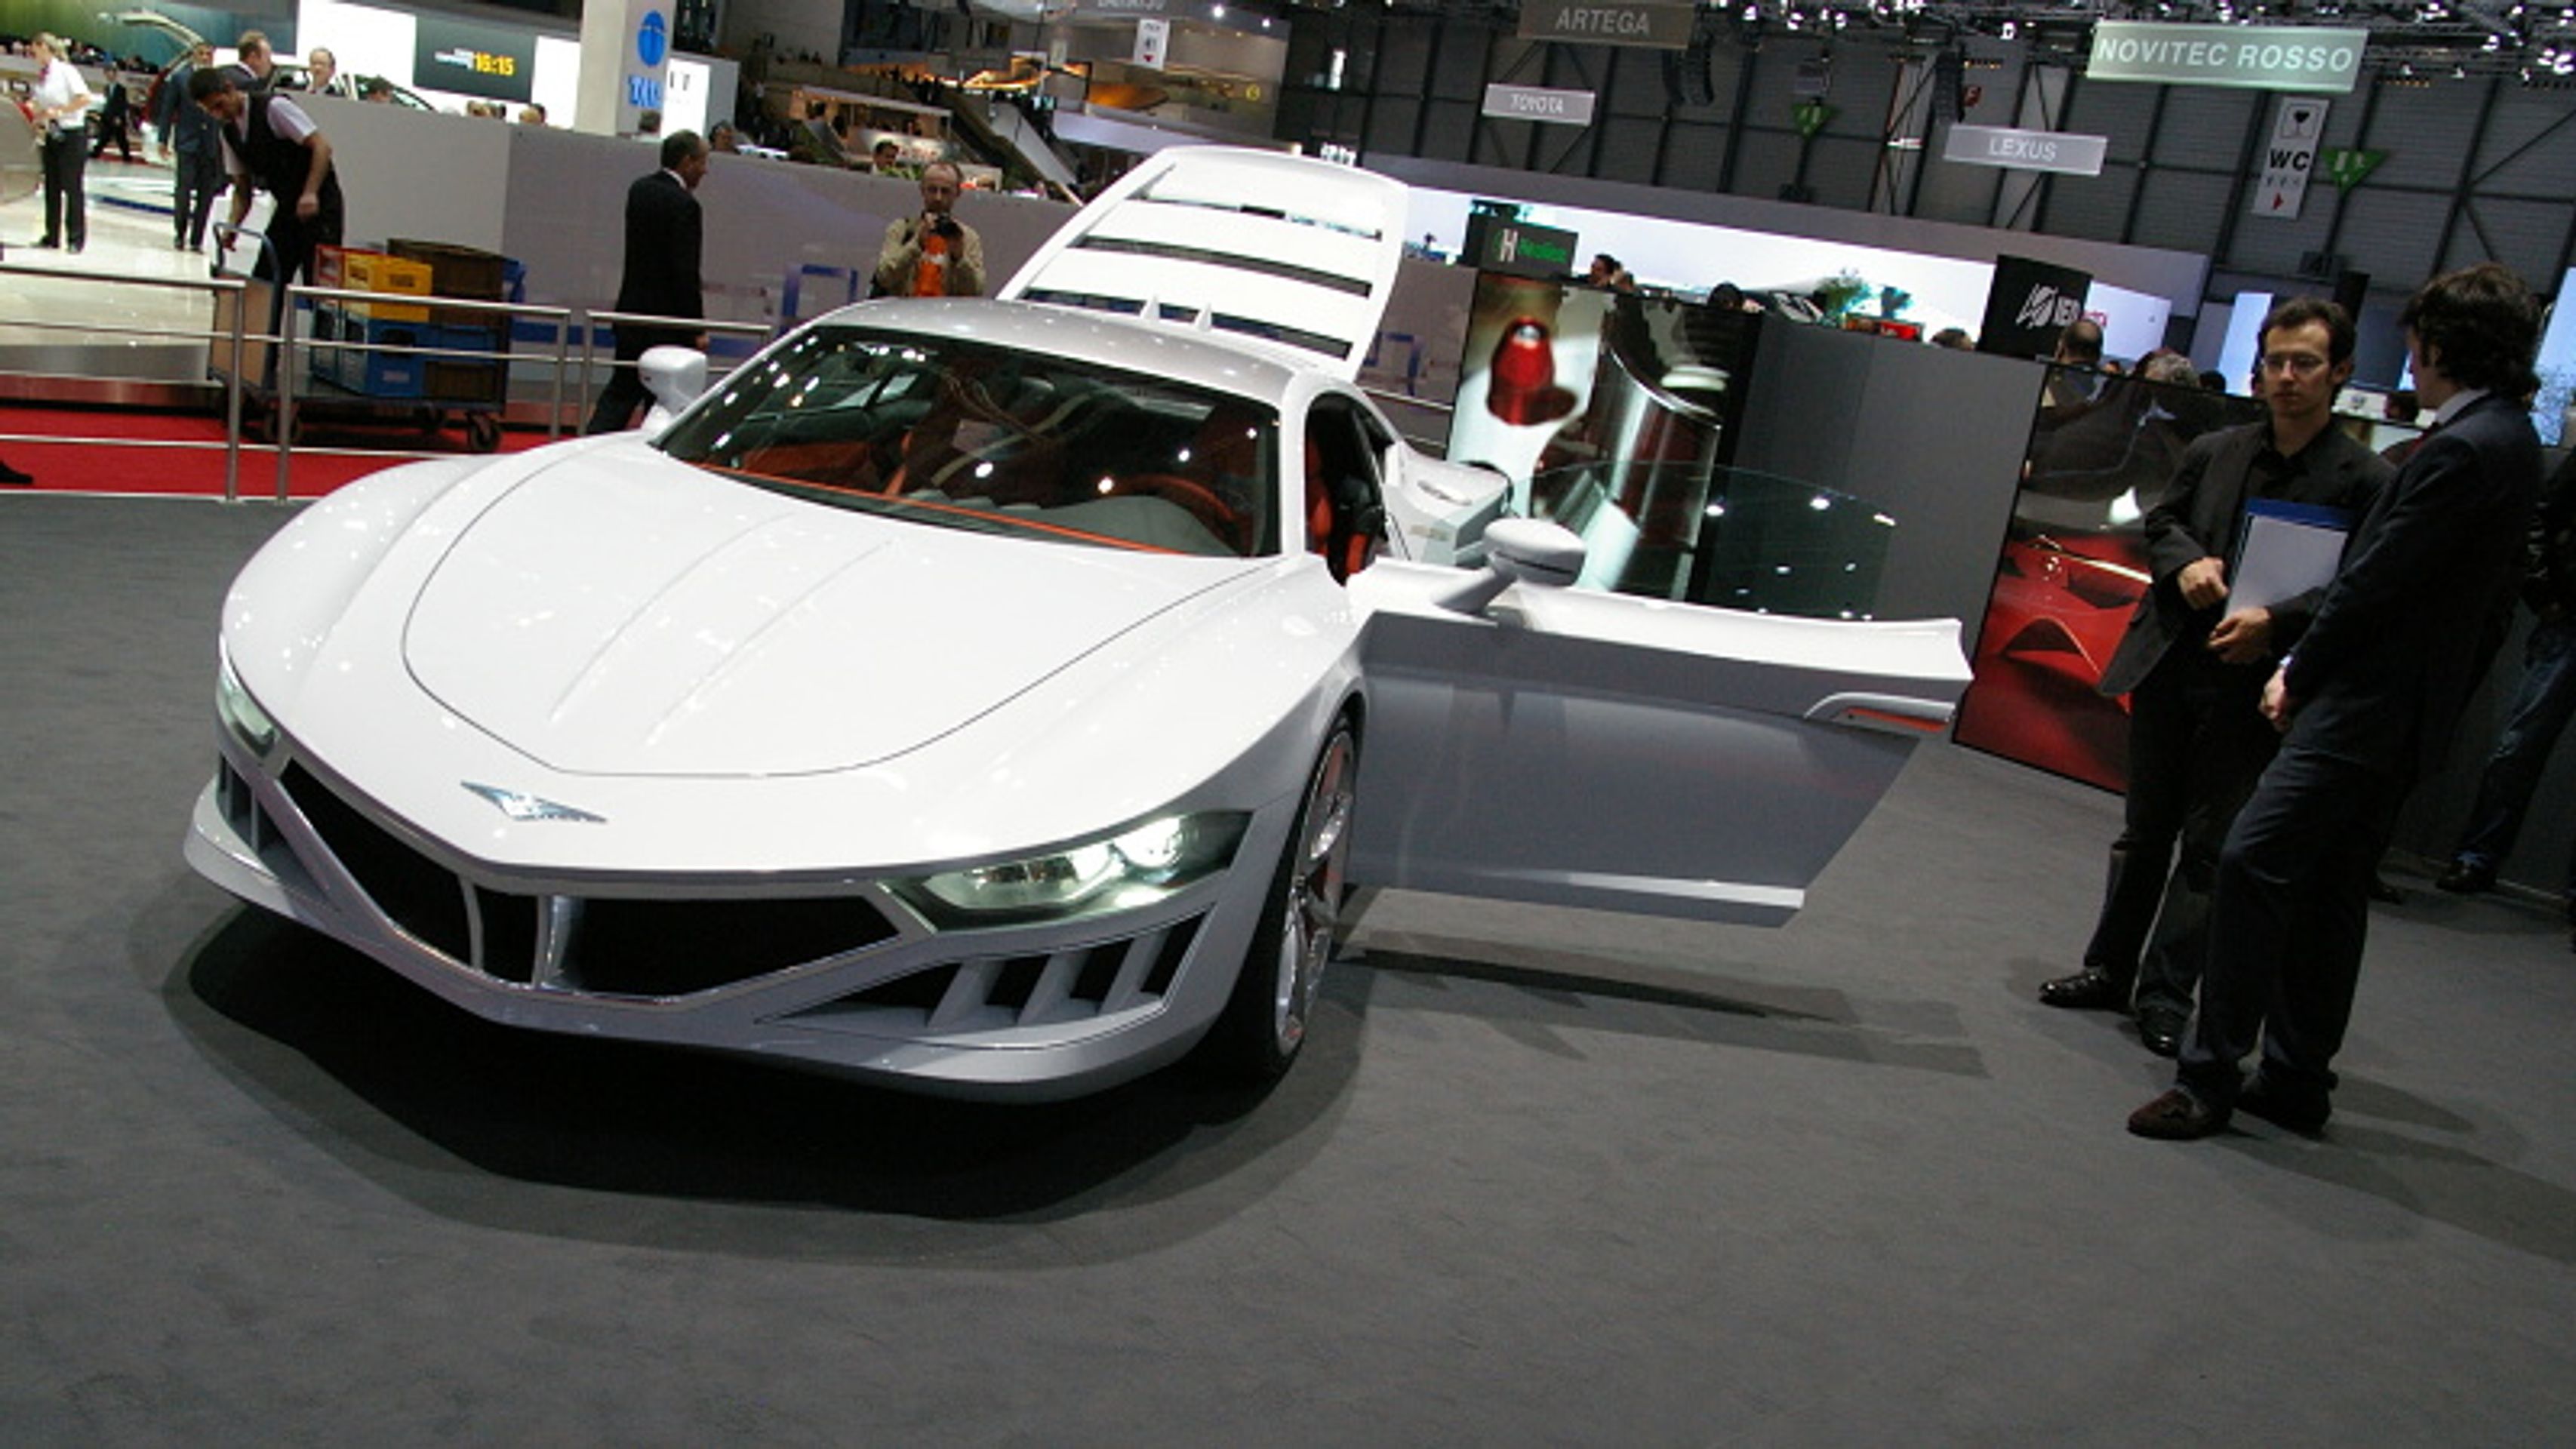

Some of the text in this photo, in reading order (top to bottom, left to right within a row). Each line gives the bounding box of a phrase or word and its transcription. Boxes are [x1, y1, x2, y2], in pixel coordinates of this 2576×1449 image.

[1555, 7, 1651, 35] ARTEGA
[2097, 38, 2353, 72] NOVITEC ROSSO
[1510, 93, 1564, 113] TOYOTA
[1989, 137, 2057, 162] LEXUS
[2269, 149, 2310, 171] WC
